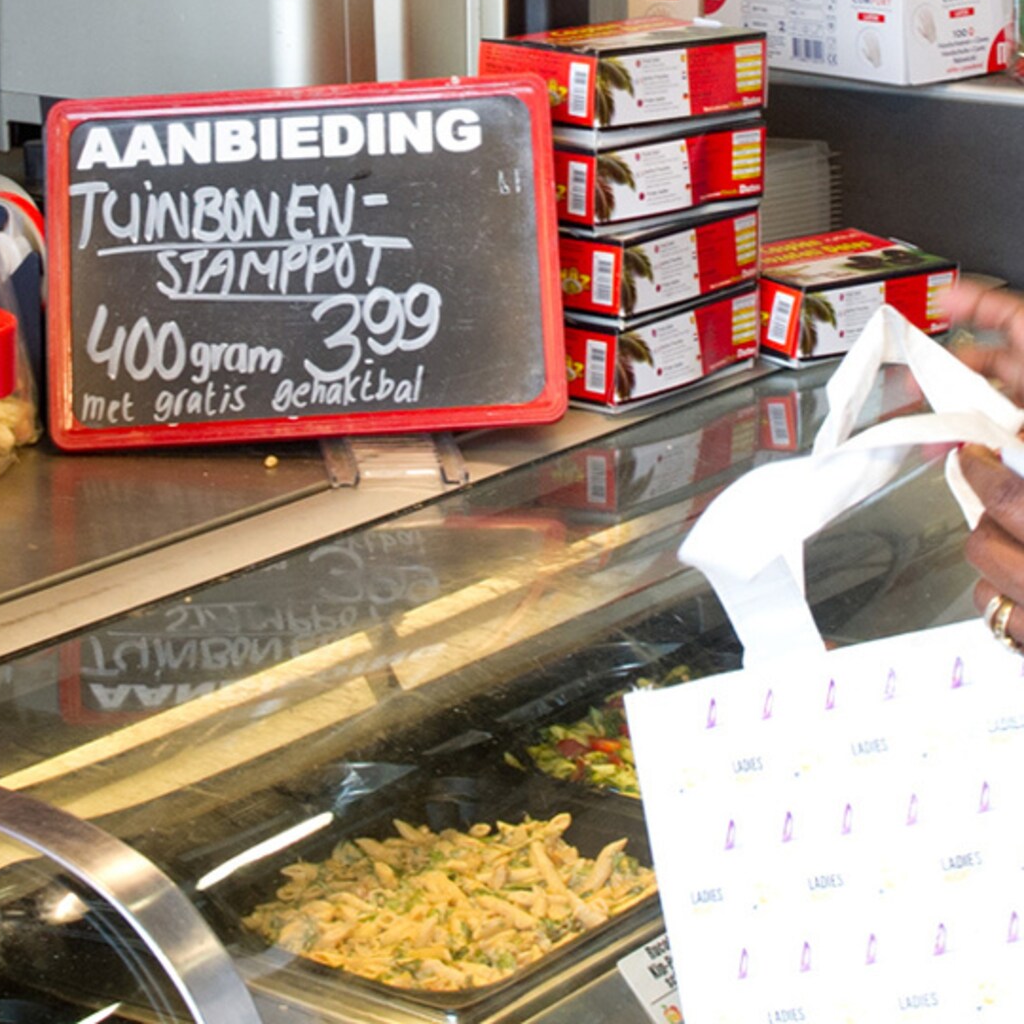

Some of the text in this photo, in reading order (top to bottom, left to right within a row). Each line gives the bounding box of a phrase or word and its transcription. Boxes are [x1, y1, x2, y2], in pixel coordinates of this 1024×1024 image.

[76, 108, 483, 170] AANBIEDING
[156, 236, 413, 299] STAMPPOT
[86, 303, 186, 381] 400
[189, 339, 283, 384] gram
[82, 364, 425, 423] met gratis gehaktbal
[851, 738, 888, 756] LADIES
[733, 757, 764, 774] LADIES
[940, 852, 983, 871] LADIES
[807, 874, 846, 891] LADIES
[690, 888, 725, 905] LADIES
[898, 992, 940, 1010] LADIES
[768, 1008, 806, 1024] LADIES
